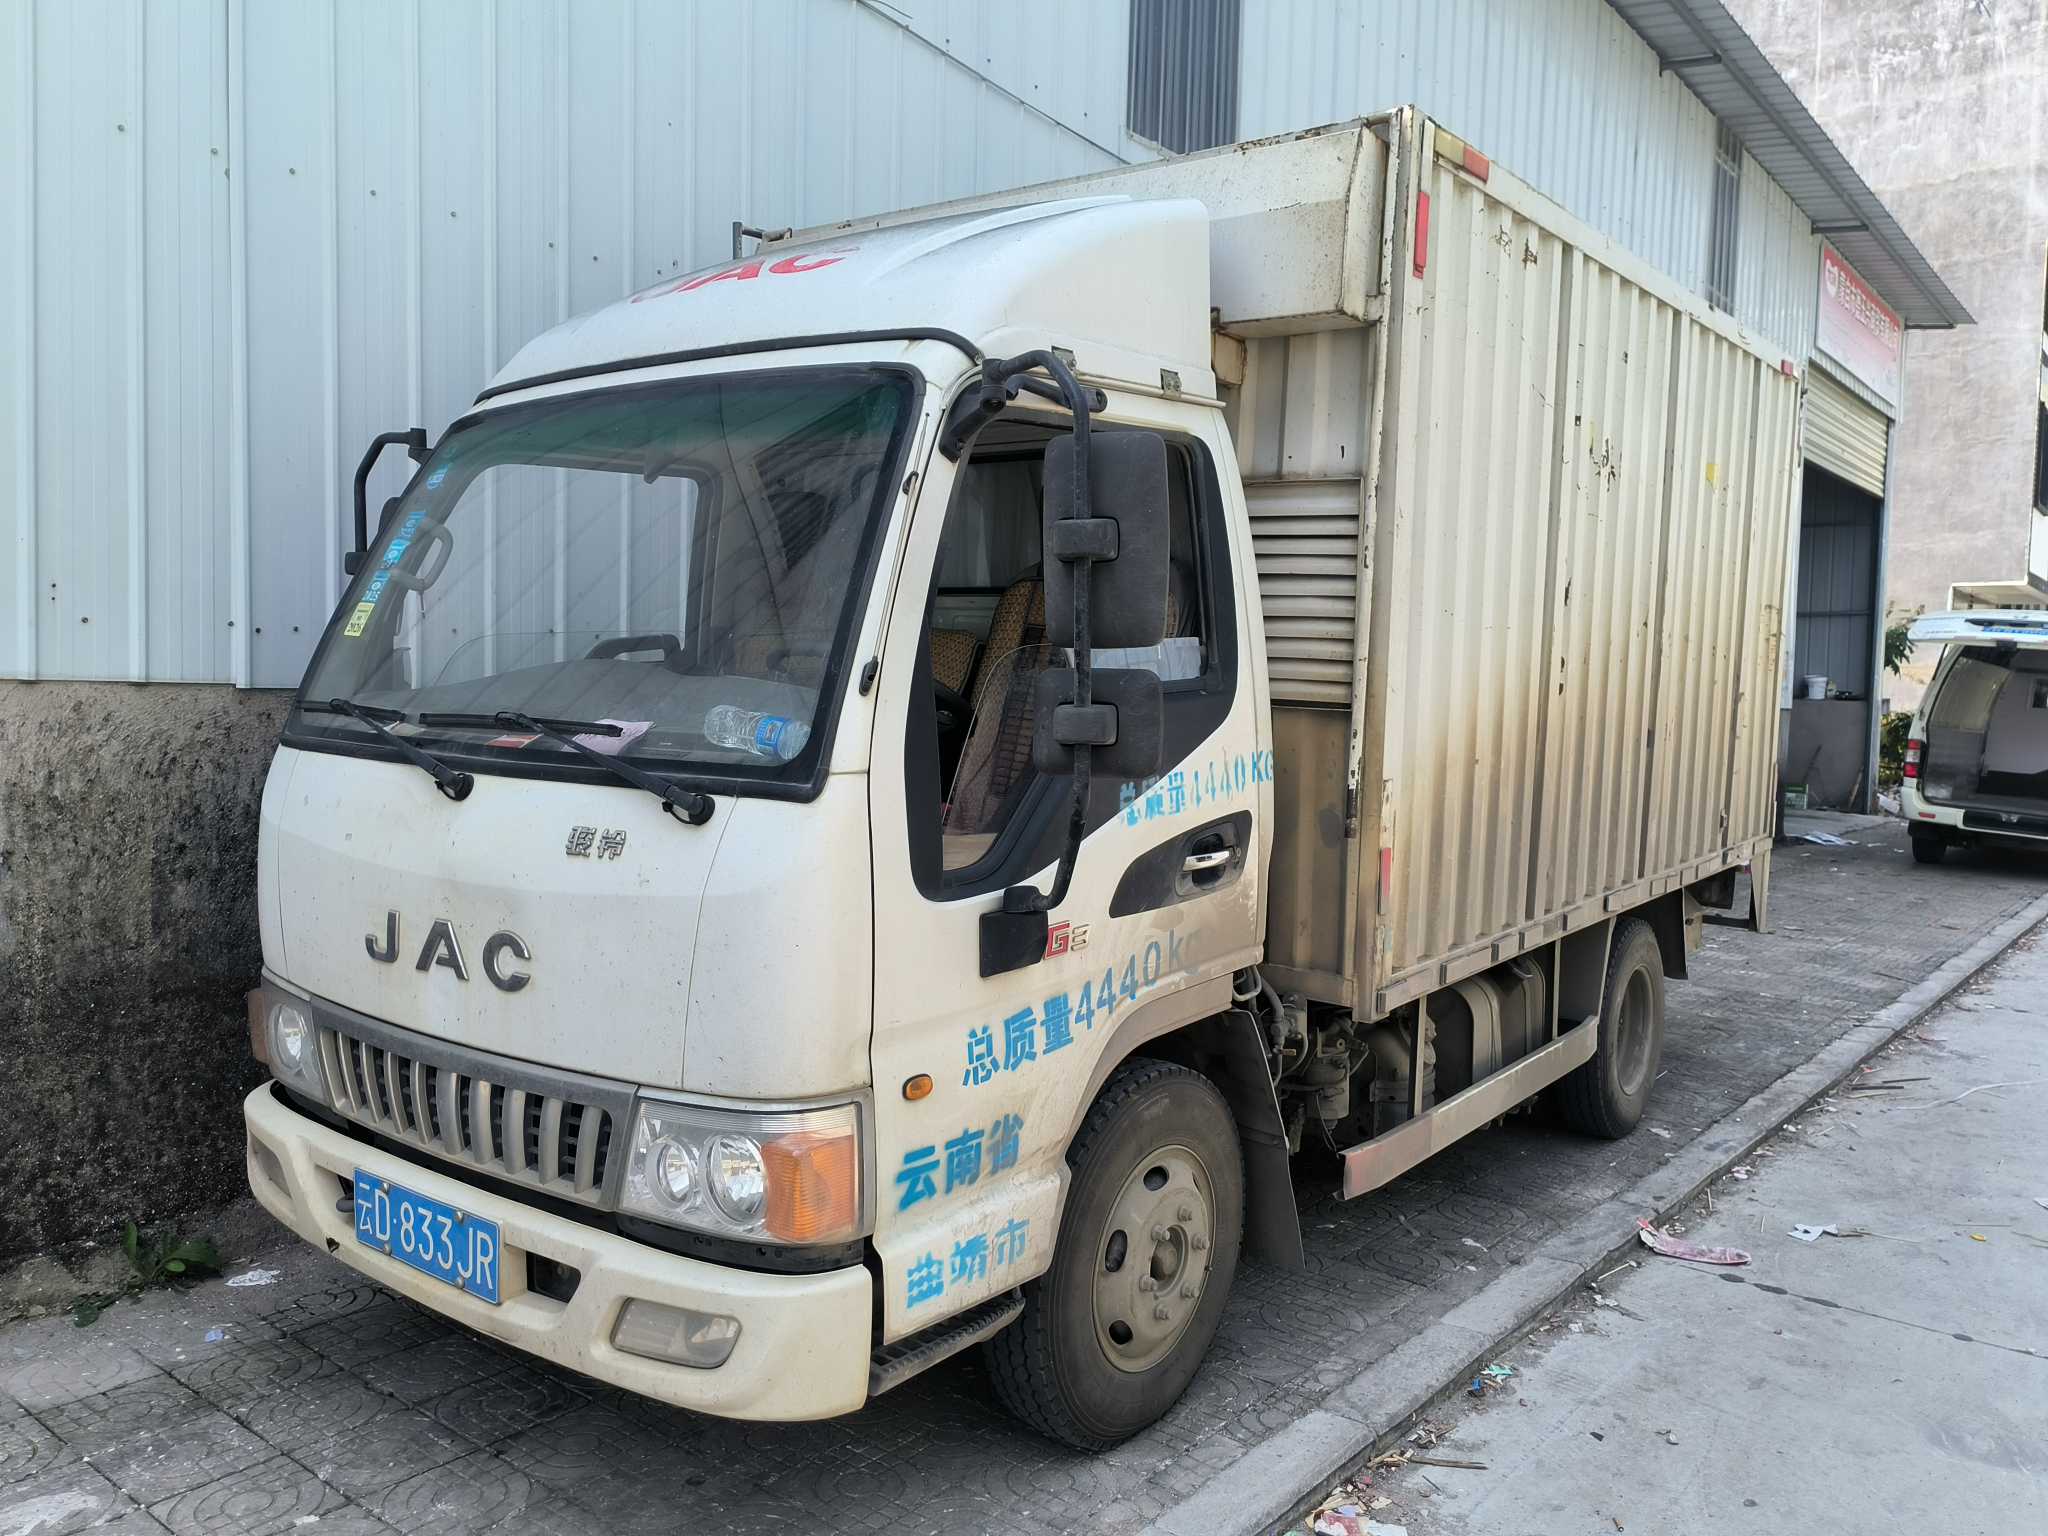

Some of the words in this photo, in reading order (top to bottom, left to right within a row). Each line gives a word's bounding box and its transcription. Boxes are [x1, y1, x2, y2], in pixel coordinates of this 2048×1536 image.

[365, 909, 532, 993] JAC
[896, 1113, 1024, 1212] 云南省
[907, 1218, 1030, 1309] 曲靖市
